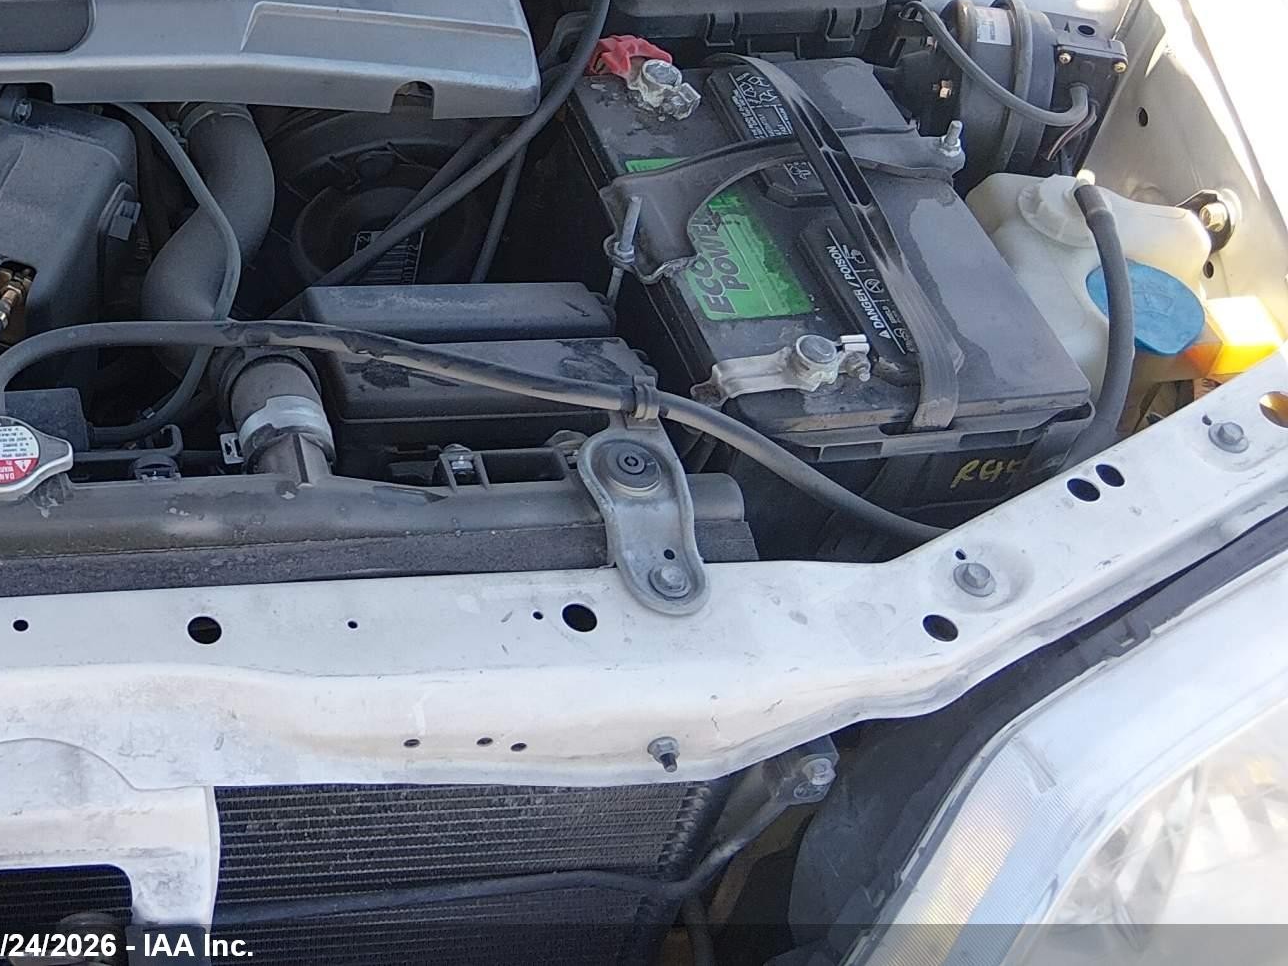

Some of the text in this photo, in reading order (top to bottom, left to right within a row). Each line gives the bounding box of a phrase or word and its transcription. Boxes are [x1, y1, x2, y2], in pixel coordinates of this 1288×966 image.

[826, 245, 856, 281] POISON
[690, 255, 737, 315] ECO
[853, 288, 885, 329] DANGER
